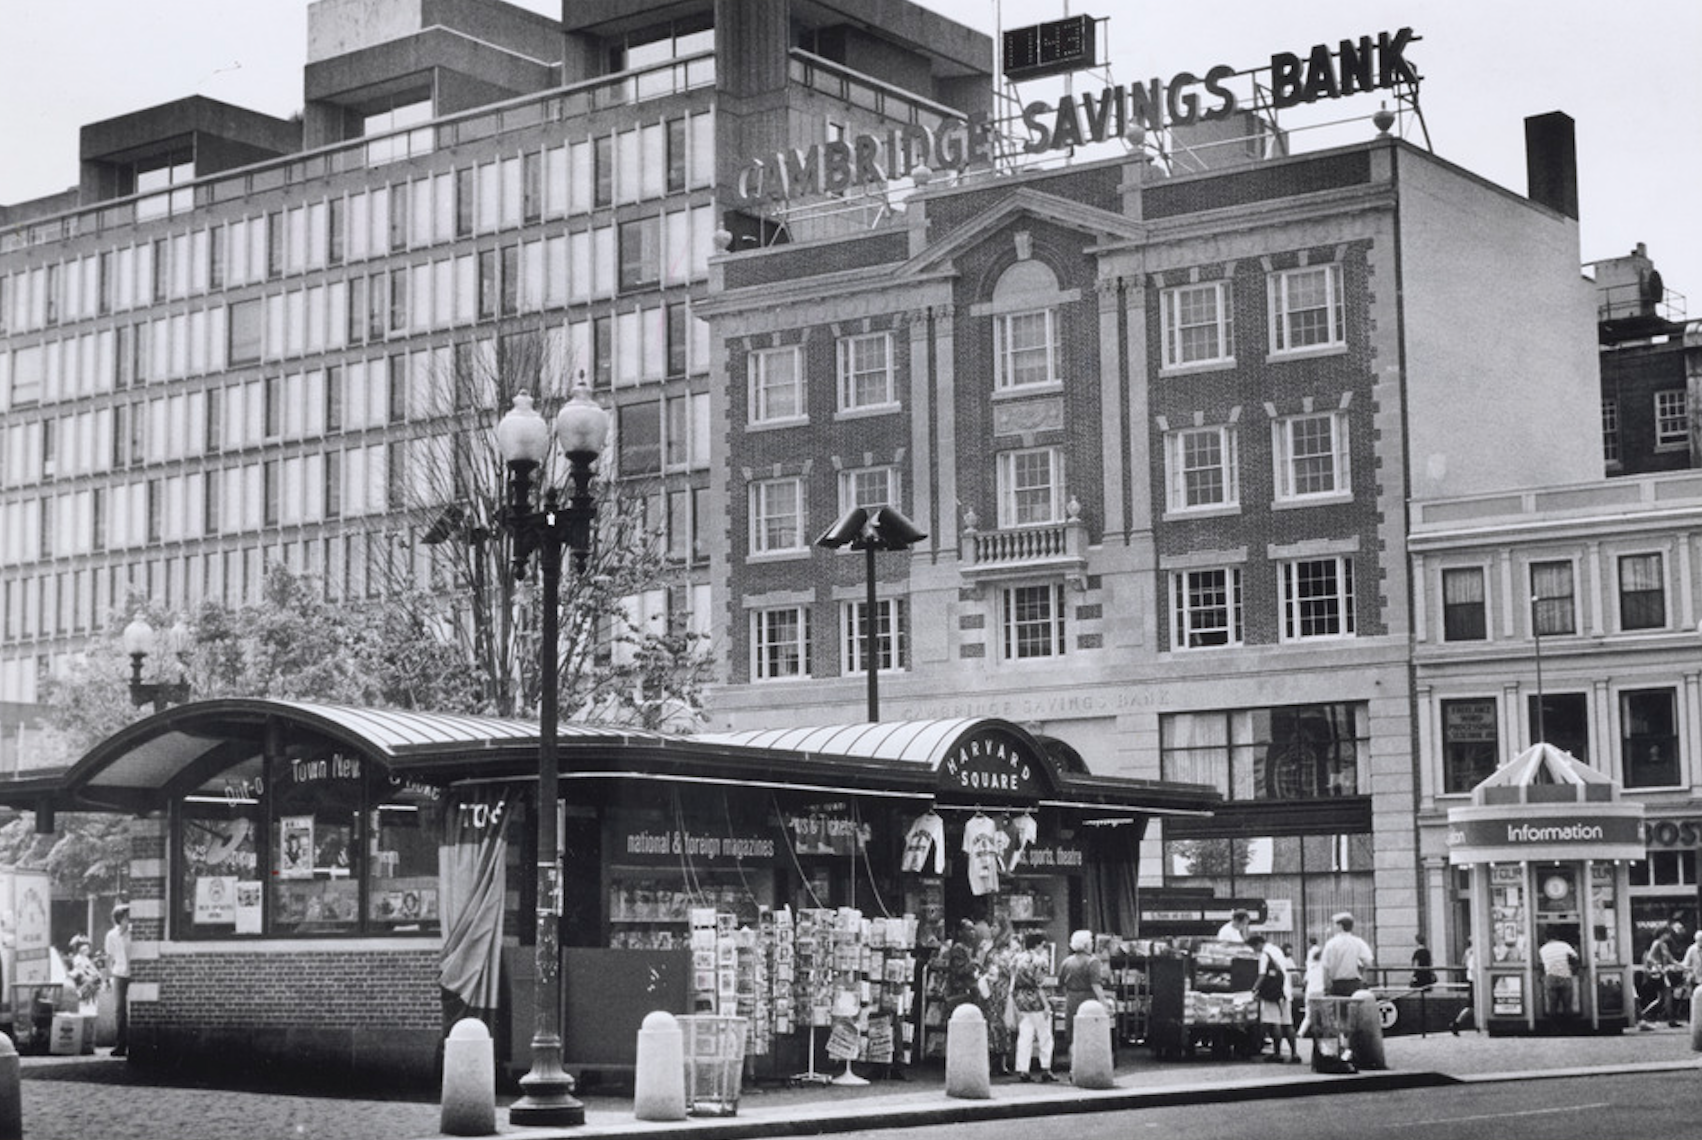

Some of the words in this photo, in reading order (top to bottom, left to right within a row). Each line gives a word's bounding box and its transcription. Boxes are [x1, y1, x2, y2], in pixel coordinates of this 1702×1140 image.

[739, 110, 993, 199] CAMBRIDGE
[1022, 65, 1237, 153] SAVINGS
[1271, 27, 1418, 109] BANK
[291, 758, 327, 782] Town
[947, 740, 1031, 780] HARVARD
[961, 770, 1018, 789] SQUARE
[1507, 823, 1604, 841] Information
[627, 832, 670, 854] national
[672, 831, 682, 854] &
[685, 831, 720, 860] foreign
[722, 834, 774, 860] magazines
